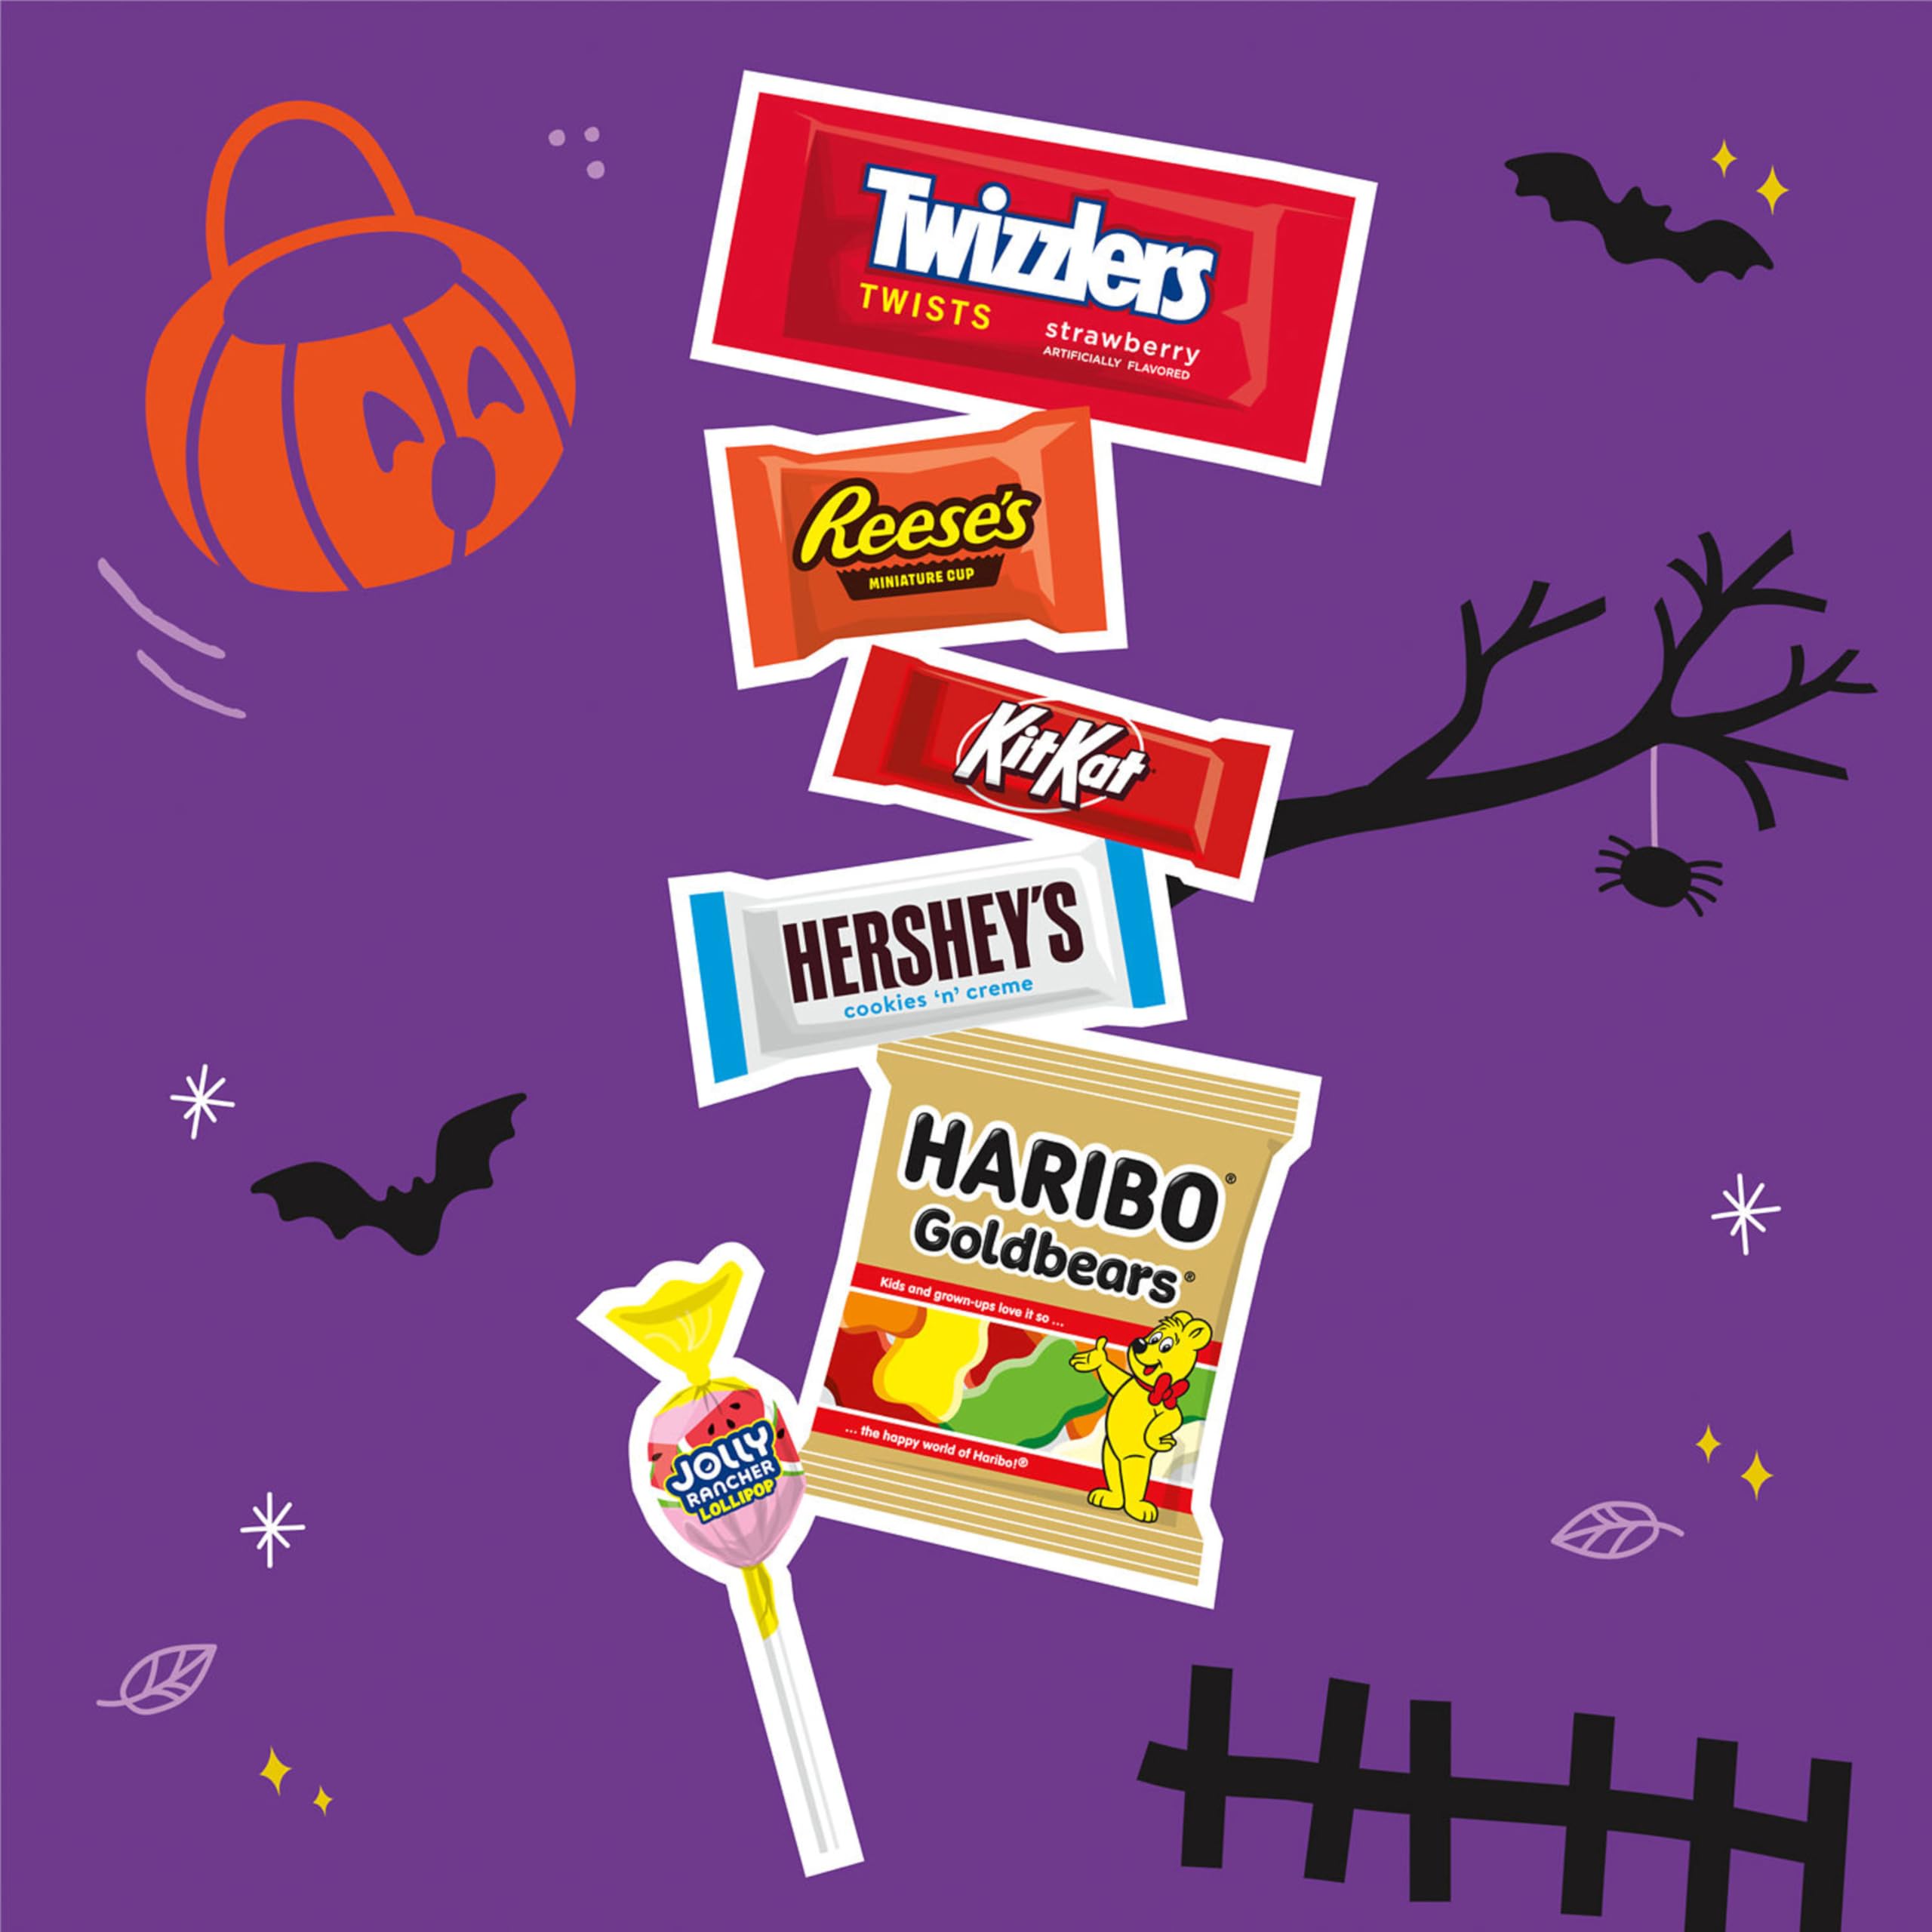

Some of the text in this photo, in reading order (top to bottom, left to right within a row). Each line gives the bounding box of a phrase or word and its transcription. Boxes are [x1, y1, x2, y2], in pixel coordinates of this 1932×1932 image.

[866, 167, 1214, 321] Twizzlers
[860, 282, 991, 330] TWISTS
[1043, 346, 1190, 380] ARTIFICIALLY FLAVORED
[1045, 321, 1201, 366] strawberry
[800, 485, 1033, 564] Reese's
[869, 568, 974, 590] MINIATURE CUP
[783, 881, 1084, 1003] HERSHEY'S
[844, 994, 927, 1019] cookies
[966, 979, 1033, 1000] creme
[880, 1276, 905, 1292] Kids
[908, 1286, 932, 1297] and
[934, 1291, 995, 1312] grown-ups
[998, 1303, 1022, 1317] love
[1025, 1308, 1033, 1319] it
[1035, 1314, 1050, 1324] so
[671, 1426, 768, 1491] JOLLY
[861, 1425, 880, 1438] the
[883, 1430, 919, 1450] happy
[922, 1439, 955, 1455] world
[958, 1447, 971, 1459] of
[686, 1460, 775, 1508] RANCHER
[699, 1479, 774, 1521] LOLLIPOP
